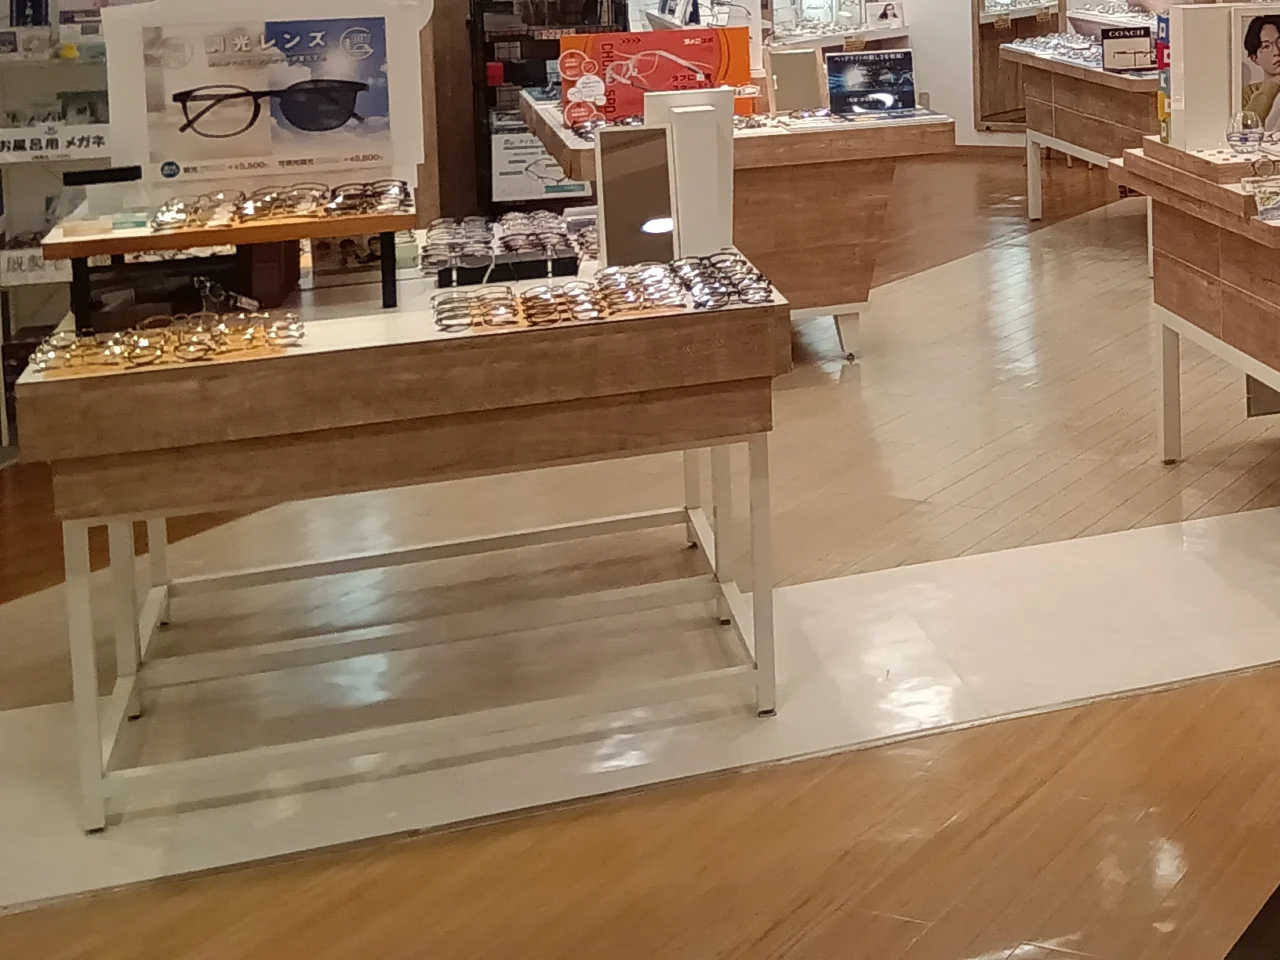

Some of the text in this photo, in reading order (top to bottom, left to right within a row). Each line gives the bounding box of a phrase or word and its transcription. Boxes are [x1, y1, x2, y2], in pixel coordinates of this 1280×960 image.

[1108, 29, 1145, 37] COACH
[65, 135, 105, 149] メガネ
